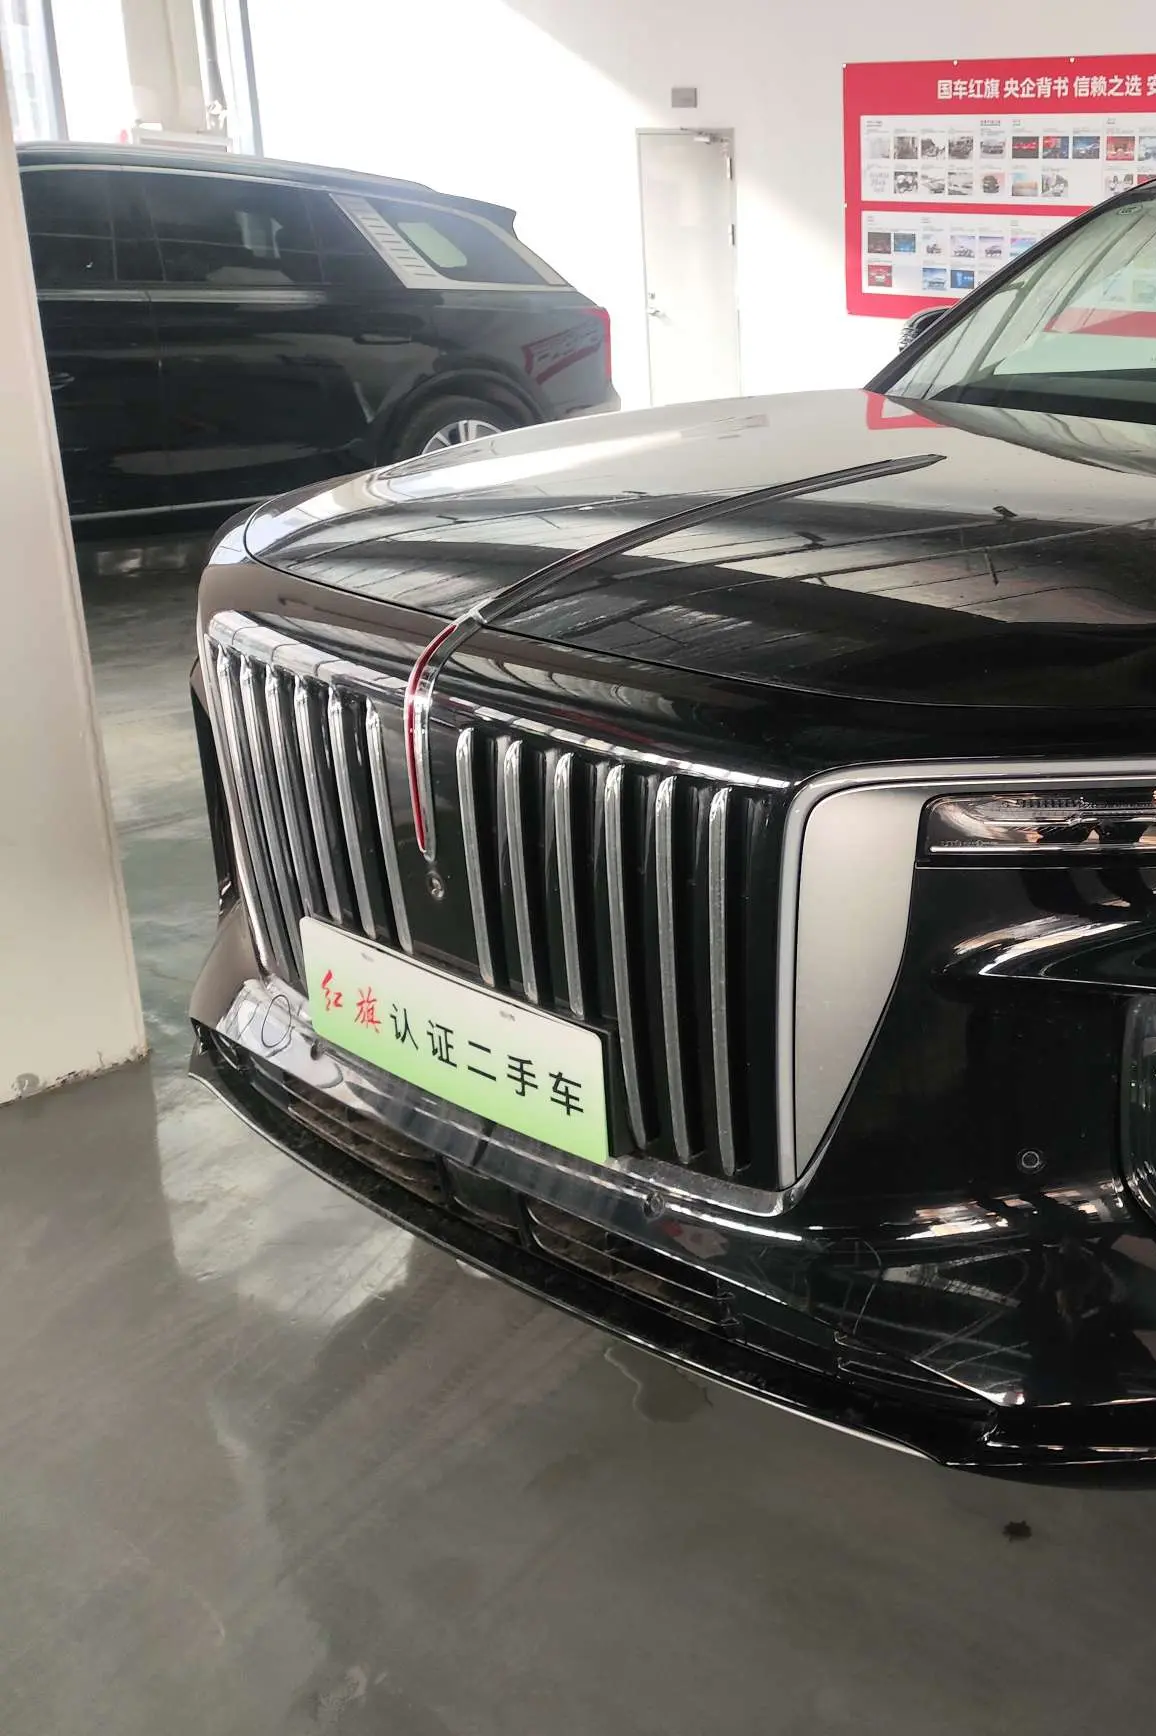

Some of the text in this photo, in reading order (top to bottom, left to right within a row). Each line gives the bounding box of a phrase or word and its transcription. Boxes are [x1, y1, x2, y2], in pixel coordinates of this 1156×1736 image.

[937, 78, 1000, 99] 国车红旗
[1003, 76, 1069, 98] 央企背书
[1073, 74, 1142, 97] 信赖之选
